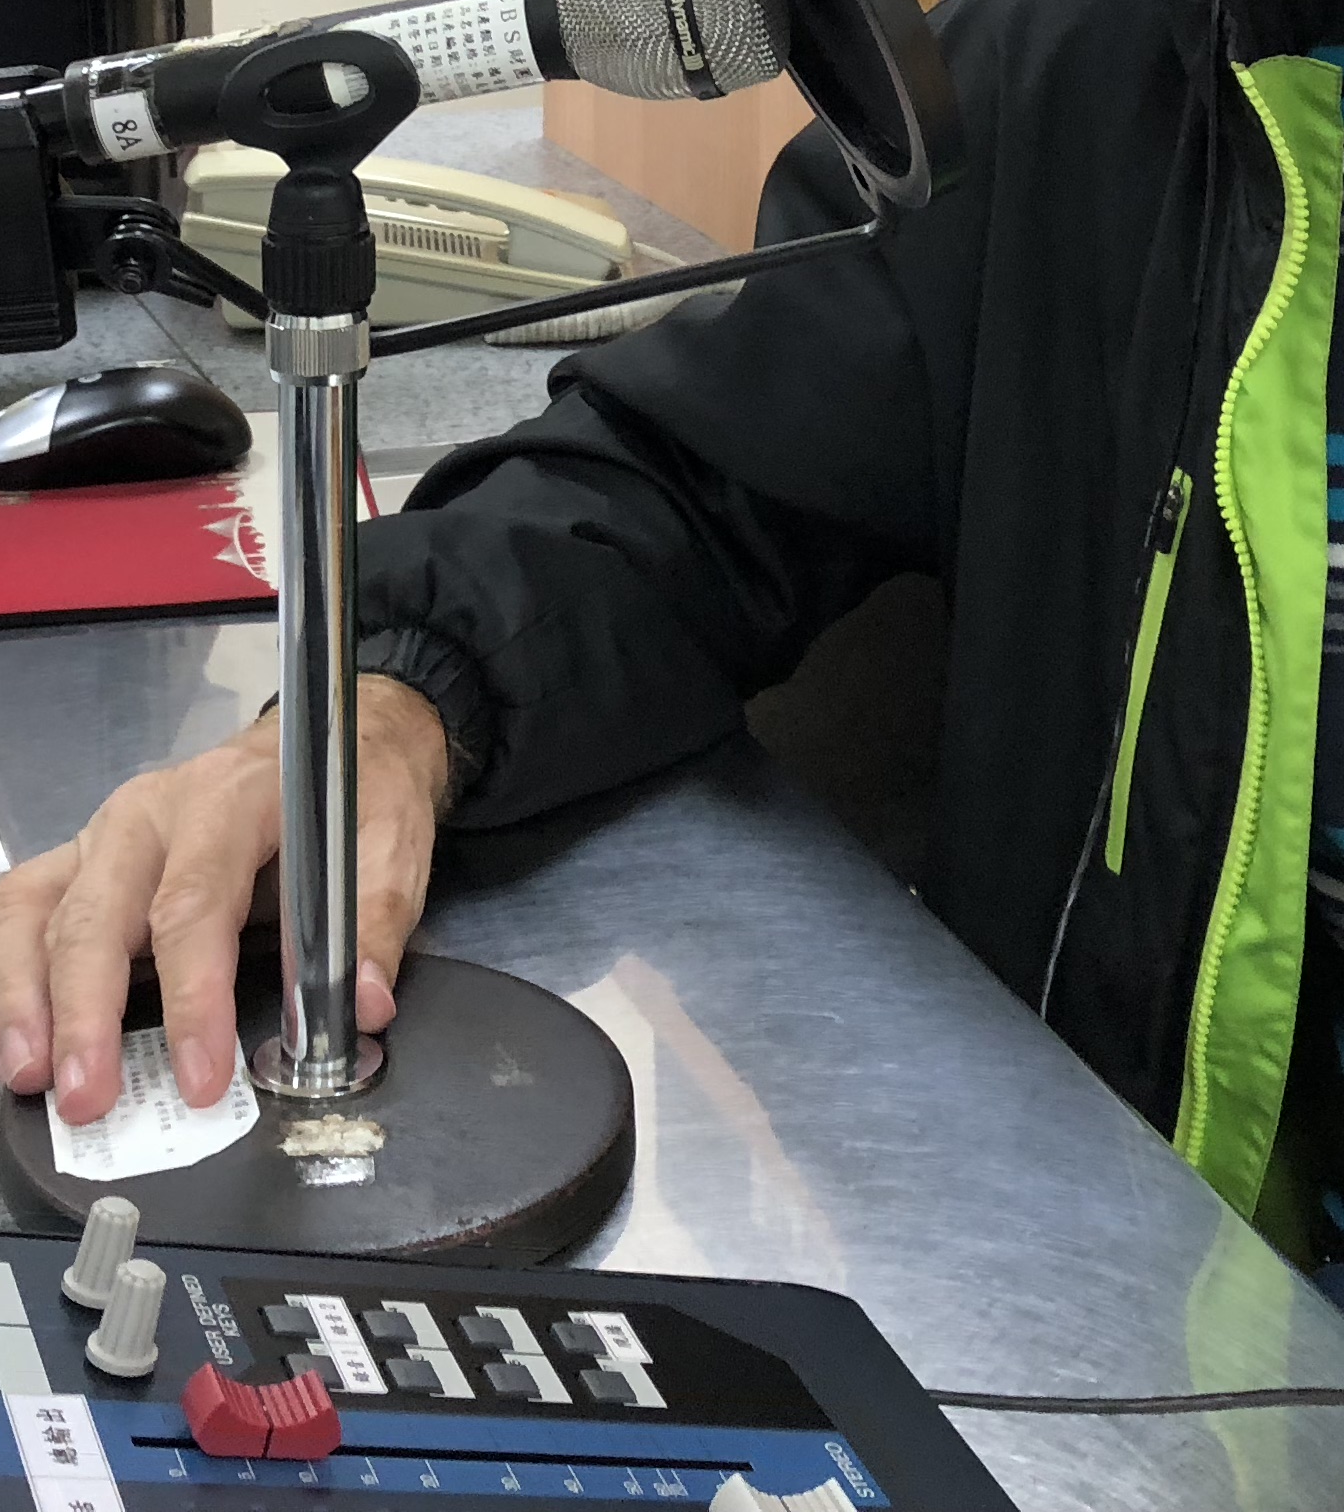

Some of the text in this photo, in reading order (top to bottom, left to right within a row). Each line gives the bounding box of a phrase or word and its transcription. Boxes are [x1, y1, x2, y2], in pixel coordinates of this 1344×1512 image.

[112, 119, 143, 151] 8A
[180, 1274, 234, 1366] USER DEFINED
[211, 1303, 241, 1338] KEYS
[824, 1441, 875, 1500] STEREO
